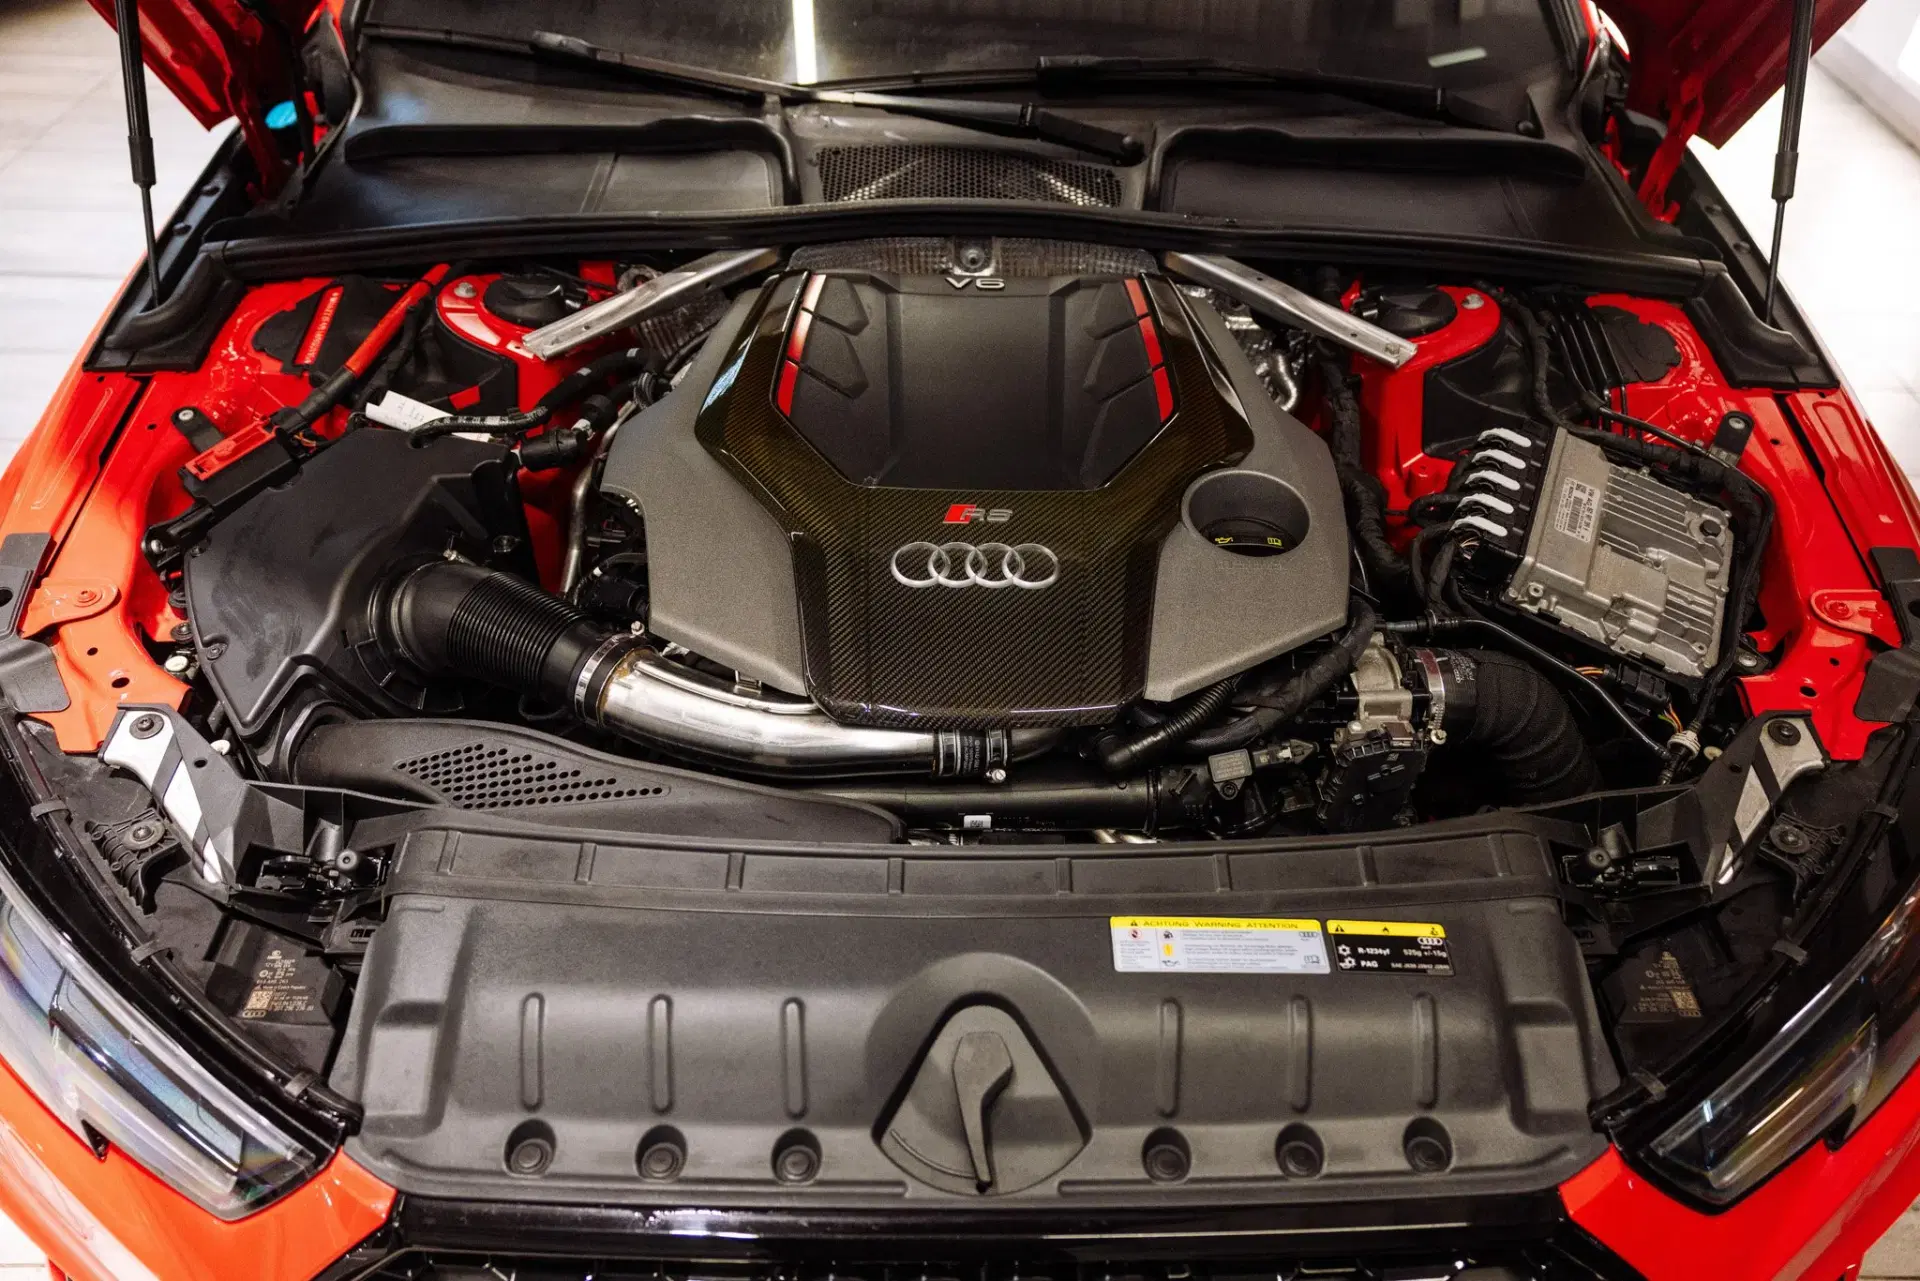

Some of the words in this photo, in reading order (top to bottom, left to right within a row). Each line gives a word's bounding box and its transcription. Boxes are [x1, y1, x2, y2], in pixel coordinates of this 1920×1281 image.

[945, 276, 1005, 289] V6
[1143, 920, 1189, 928] ACHTUNG
[1194, 921, 1241, 929] WARNING
[1246, 921, 1299, 930] ATTENTION
[1360, 960, 1379, 968] PAG
